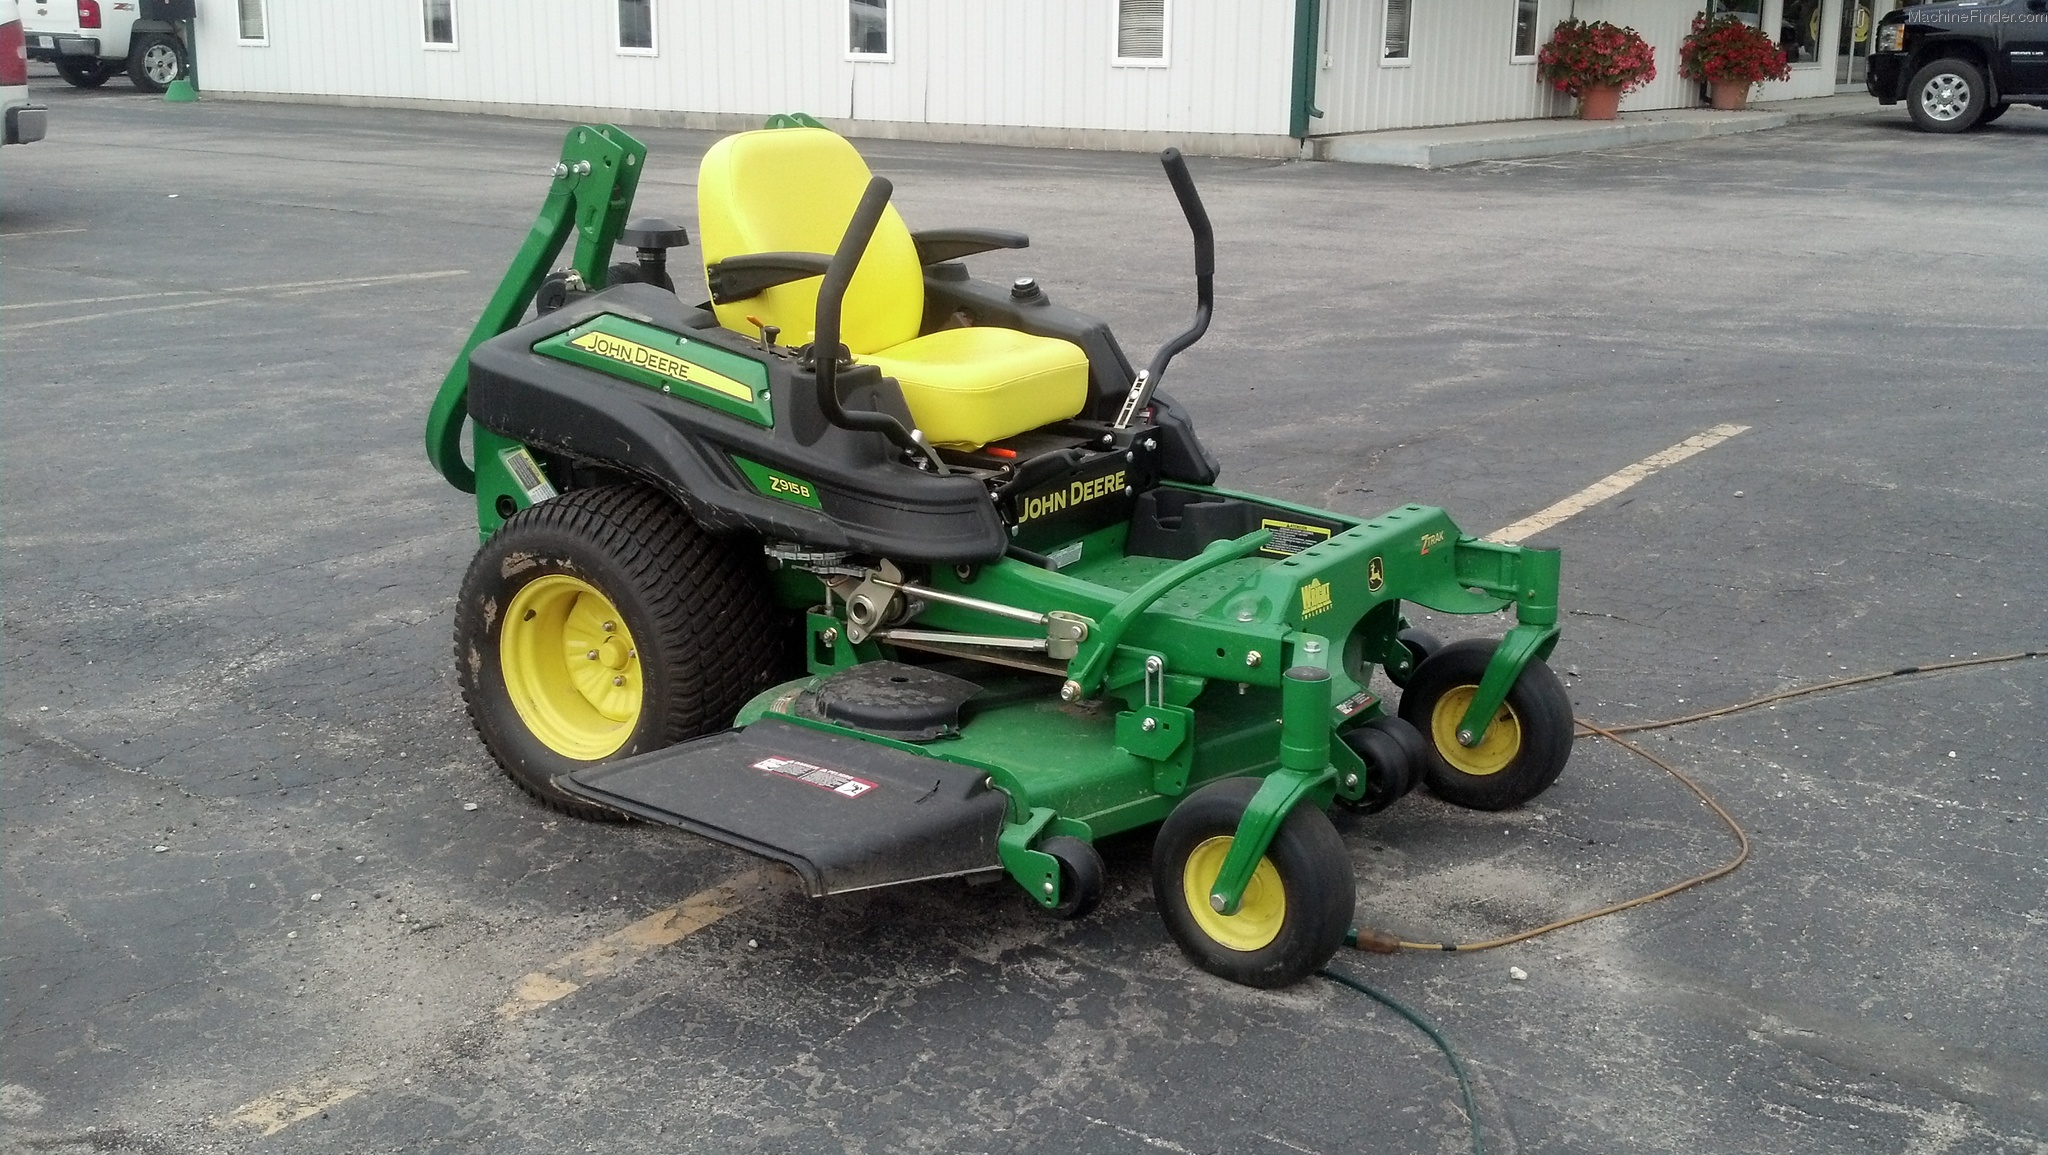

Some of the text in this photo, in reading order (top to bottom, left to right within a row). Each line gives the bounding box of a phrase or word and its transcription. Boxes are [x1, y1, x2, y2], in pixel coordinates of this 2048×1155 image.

[588, 335, 690, 379] JOHN DEERE
[769, 475, 811, 498] Z915B
[1018, 470, 1126, 524] JOHN DEERE
